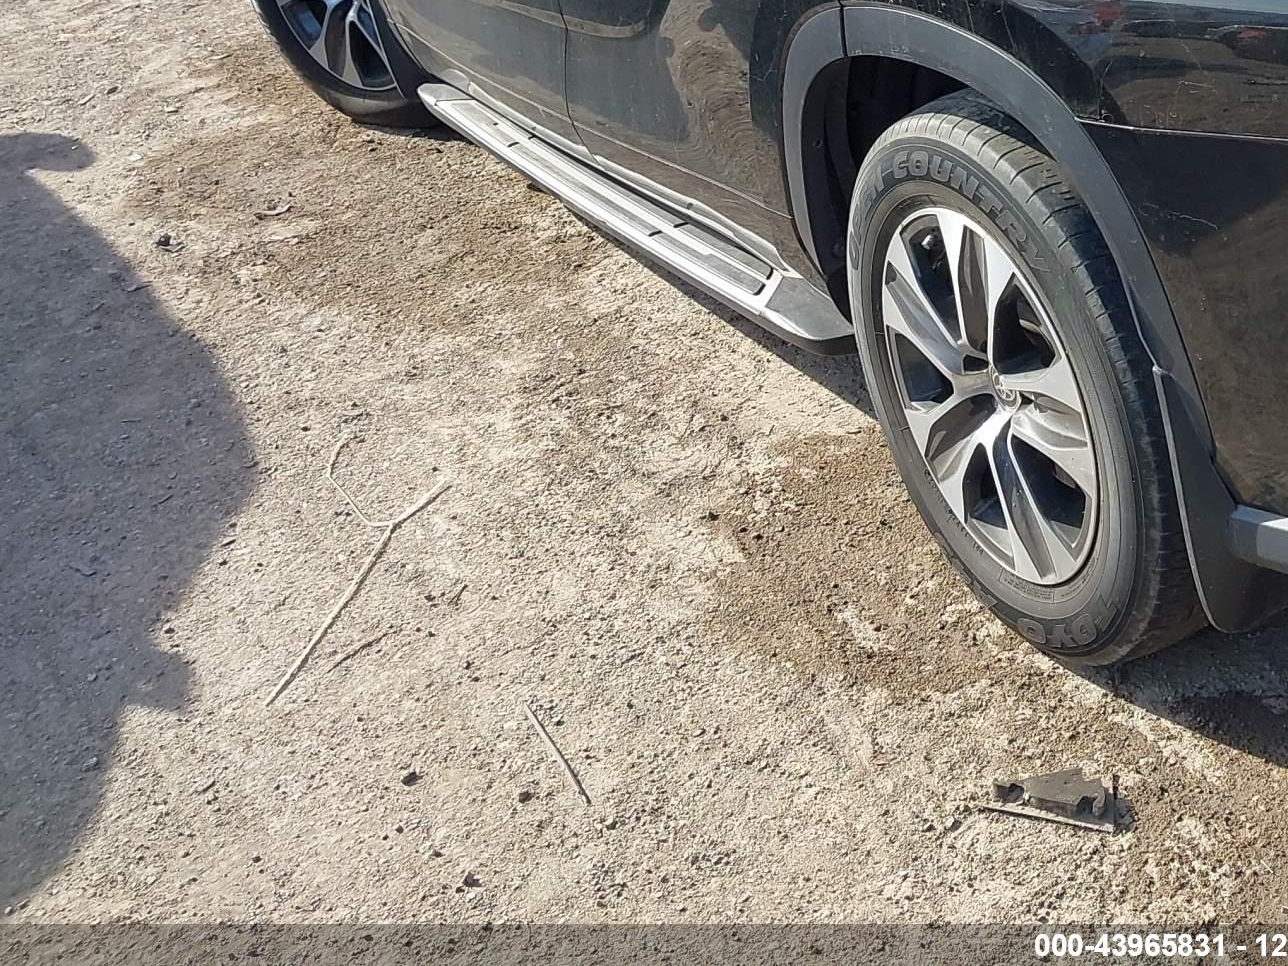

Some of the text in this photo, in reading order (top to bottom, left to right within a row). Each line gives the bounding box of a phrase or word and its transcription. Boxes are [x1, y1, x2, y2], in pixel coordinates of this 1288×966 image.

[849, 149, 1051, 274] OPEN COUNTRY
[1016, 592, 1120, 649] TOYO
